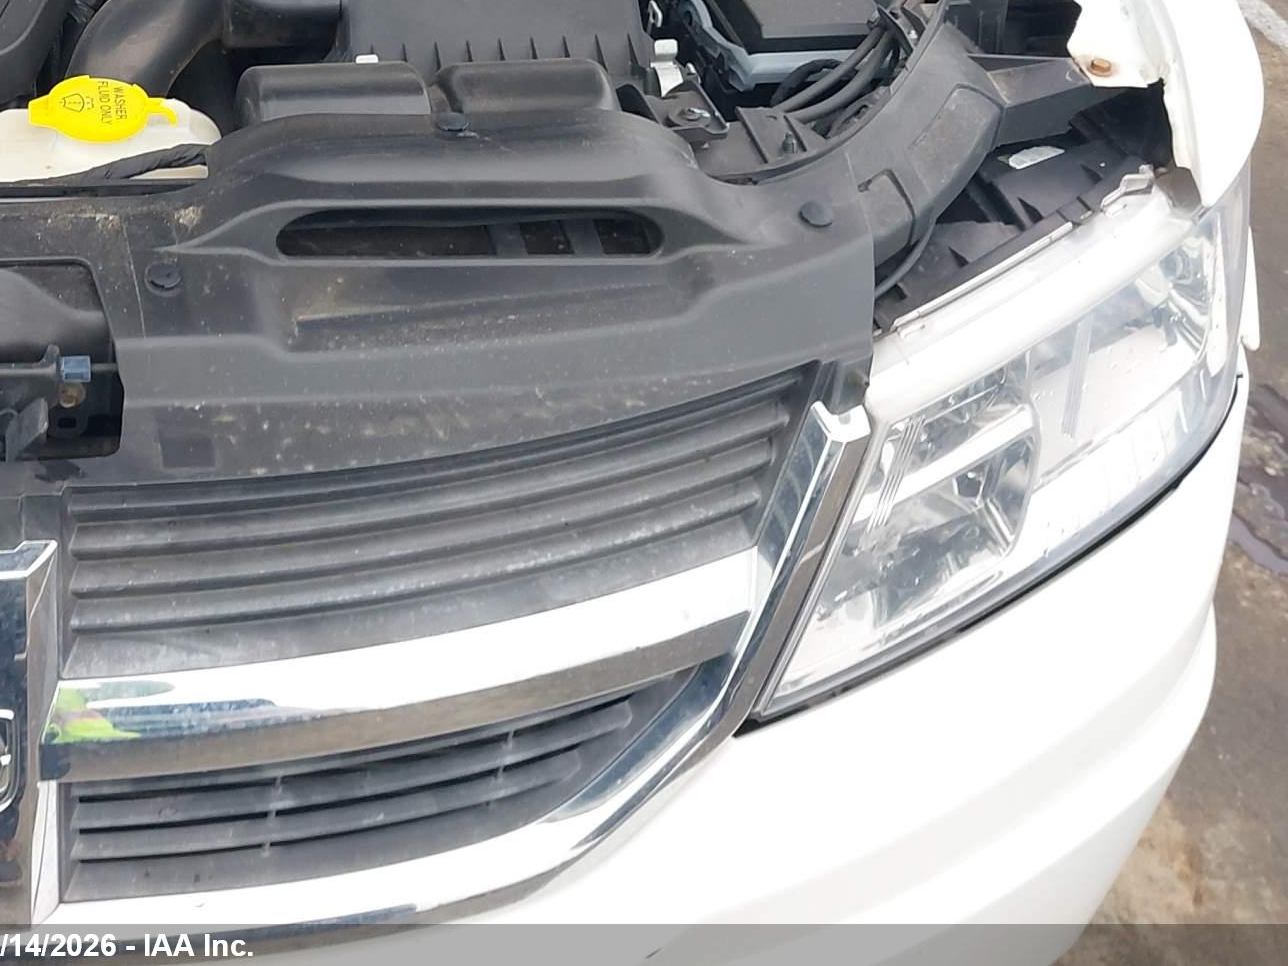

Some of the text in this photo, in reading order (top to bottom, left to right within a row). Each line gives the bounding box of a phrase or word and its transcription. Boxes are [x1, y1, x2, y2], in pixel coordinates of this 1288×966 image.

[98, 81, 112, 125] FLUID ONLY
[114, 87, 127, 120] WASHER
